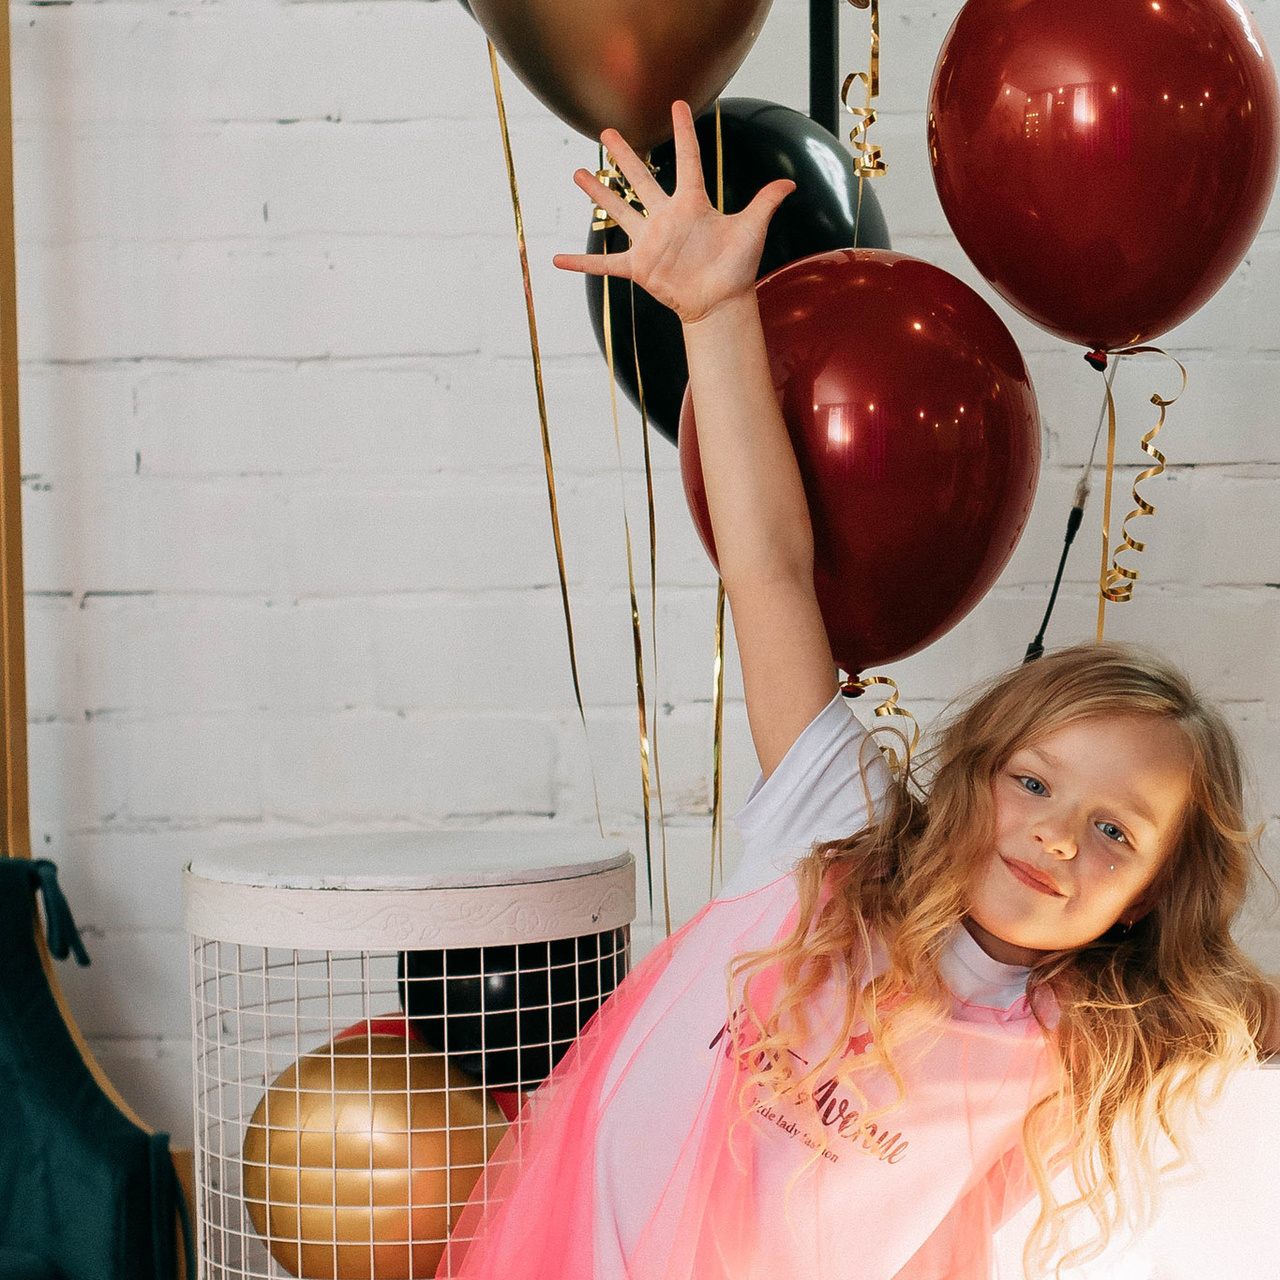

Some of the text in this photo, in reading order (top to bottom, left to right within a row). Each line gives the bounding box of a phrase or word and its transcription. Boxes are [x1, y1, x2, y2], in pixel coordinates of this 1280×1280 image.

[776, 1115, 801, 1139] lady
[799, 1132, 839, 1163] asion
[811, 1074, 909, 1165] Avenue
